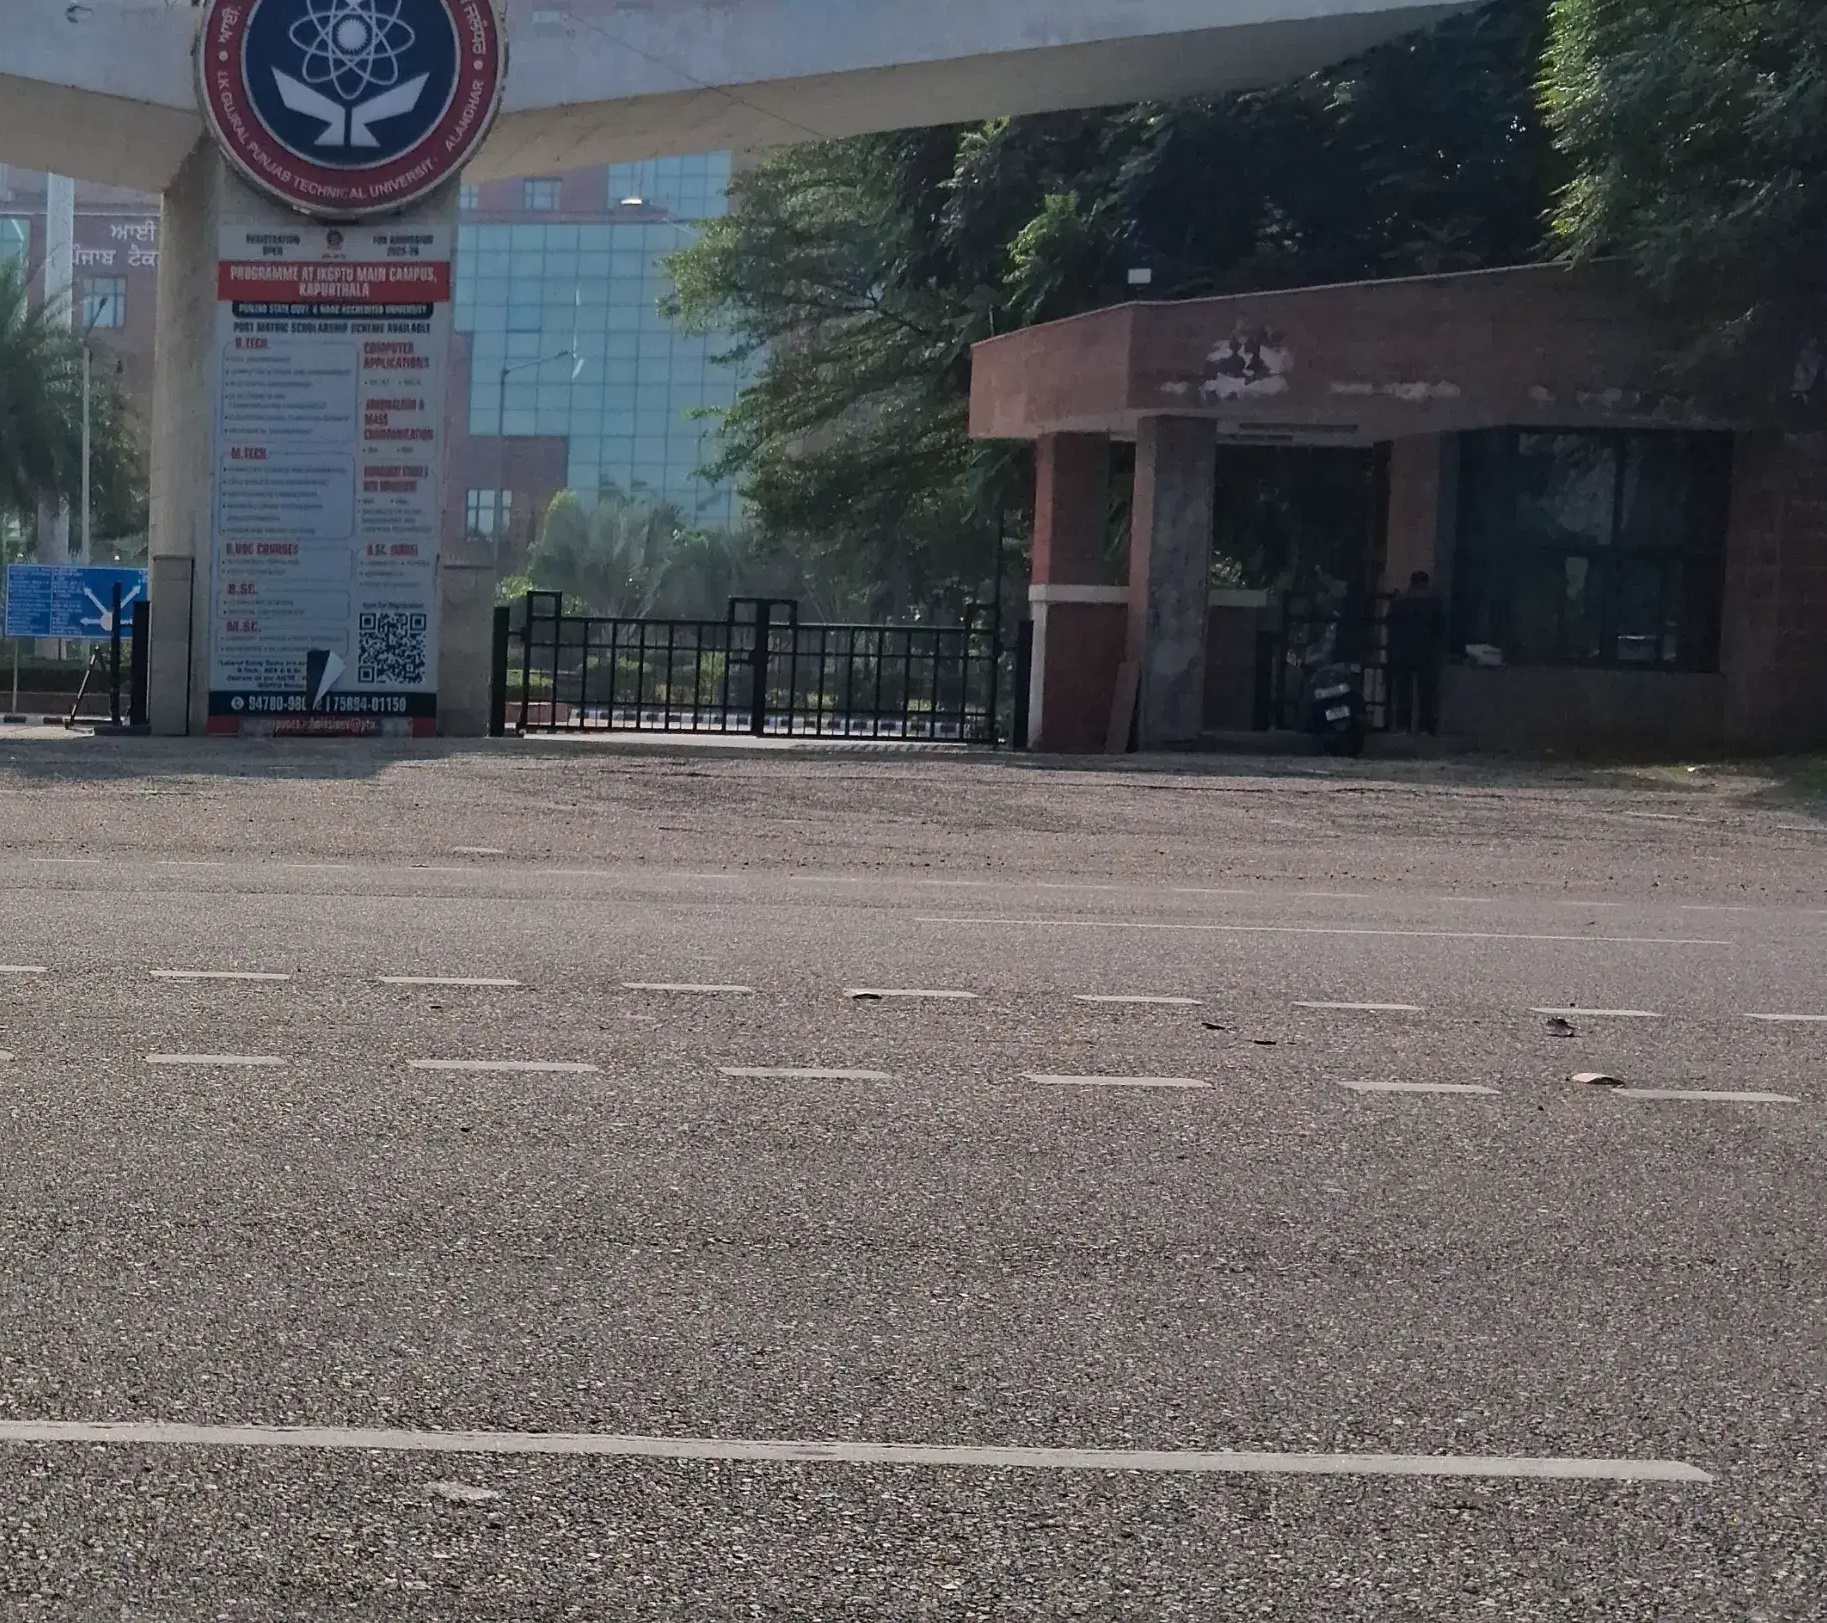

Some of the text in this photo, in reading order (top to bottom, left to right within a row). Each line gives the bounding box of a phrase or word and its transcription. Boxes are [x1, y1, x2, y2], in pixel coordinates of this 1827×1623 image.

[221, 92, 250, 145] GUJRAL
[246, 142, 292, 182] PUNJAB
[293, 176, 367, 199] TECHNICAL
[127, 244, 160, 266] ਟੈਕ
[230, 265, 298, 280] PROGRAMME
[302, 266, 314, 281] AT
[357, 266, 386, 282] MAIN
[389, 266, 437, 284] CAMPUS,
[299, 282, 370, 297] KAPURTHALA
